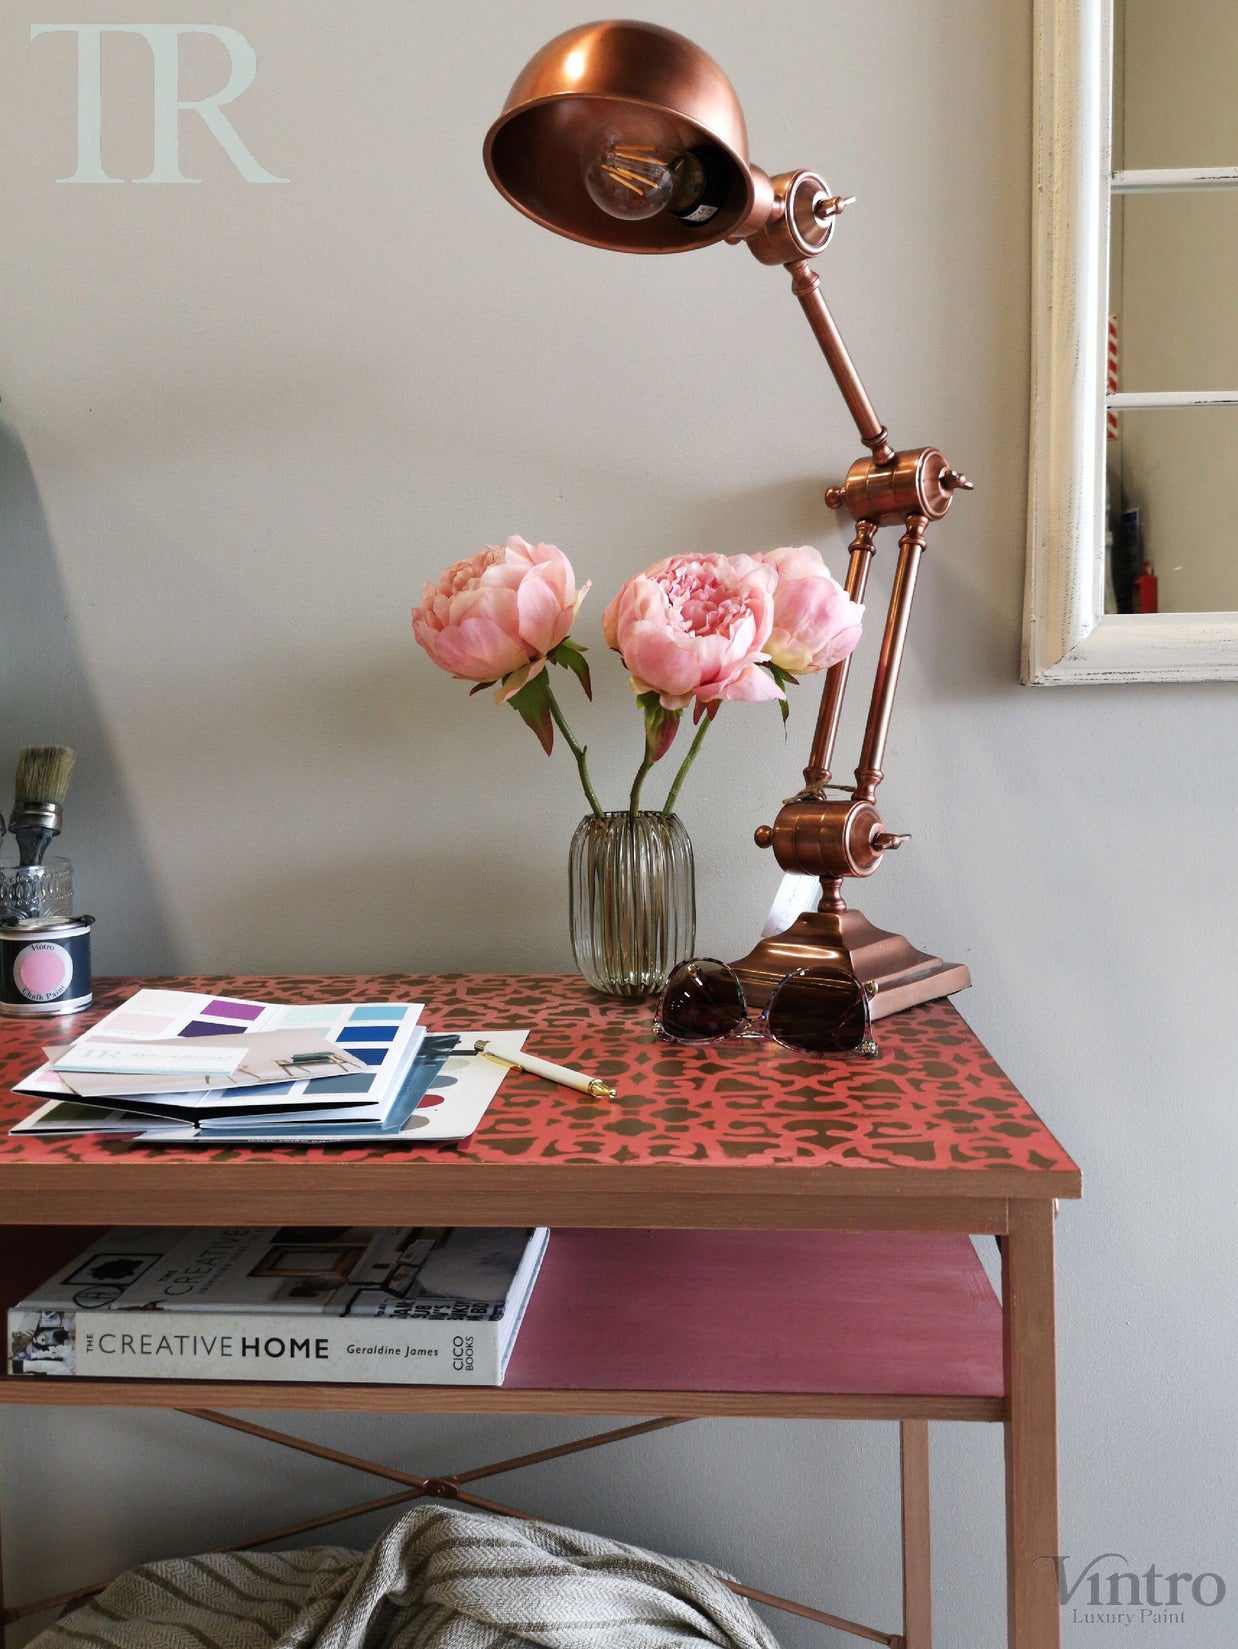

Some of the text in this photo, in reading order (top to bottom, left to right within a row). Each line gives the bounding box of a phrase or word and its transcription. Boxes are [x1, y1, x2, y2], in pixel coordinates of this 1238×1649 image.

[31, 944, 55, 952] Vintro
[22, 985, 65, 1000] Chalk Paint
[164, 1229, 250, 1296] CREATIVE
[86, 1333, 439, 1359] THE CREATIVE HOME Geraldine James
[452, 1335, 464, 1371] CICO
[465, 1336, 474, 1371] BOOKS
